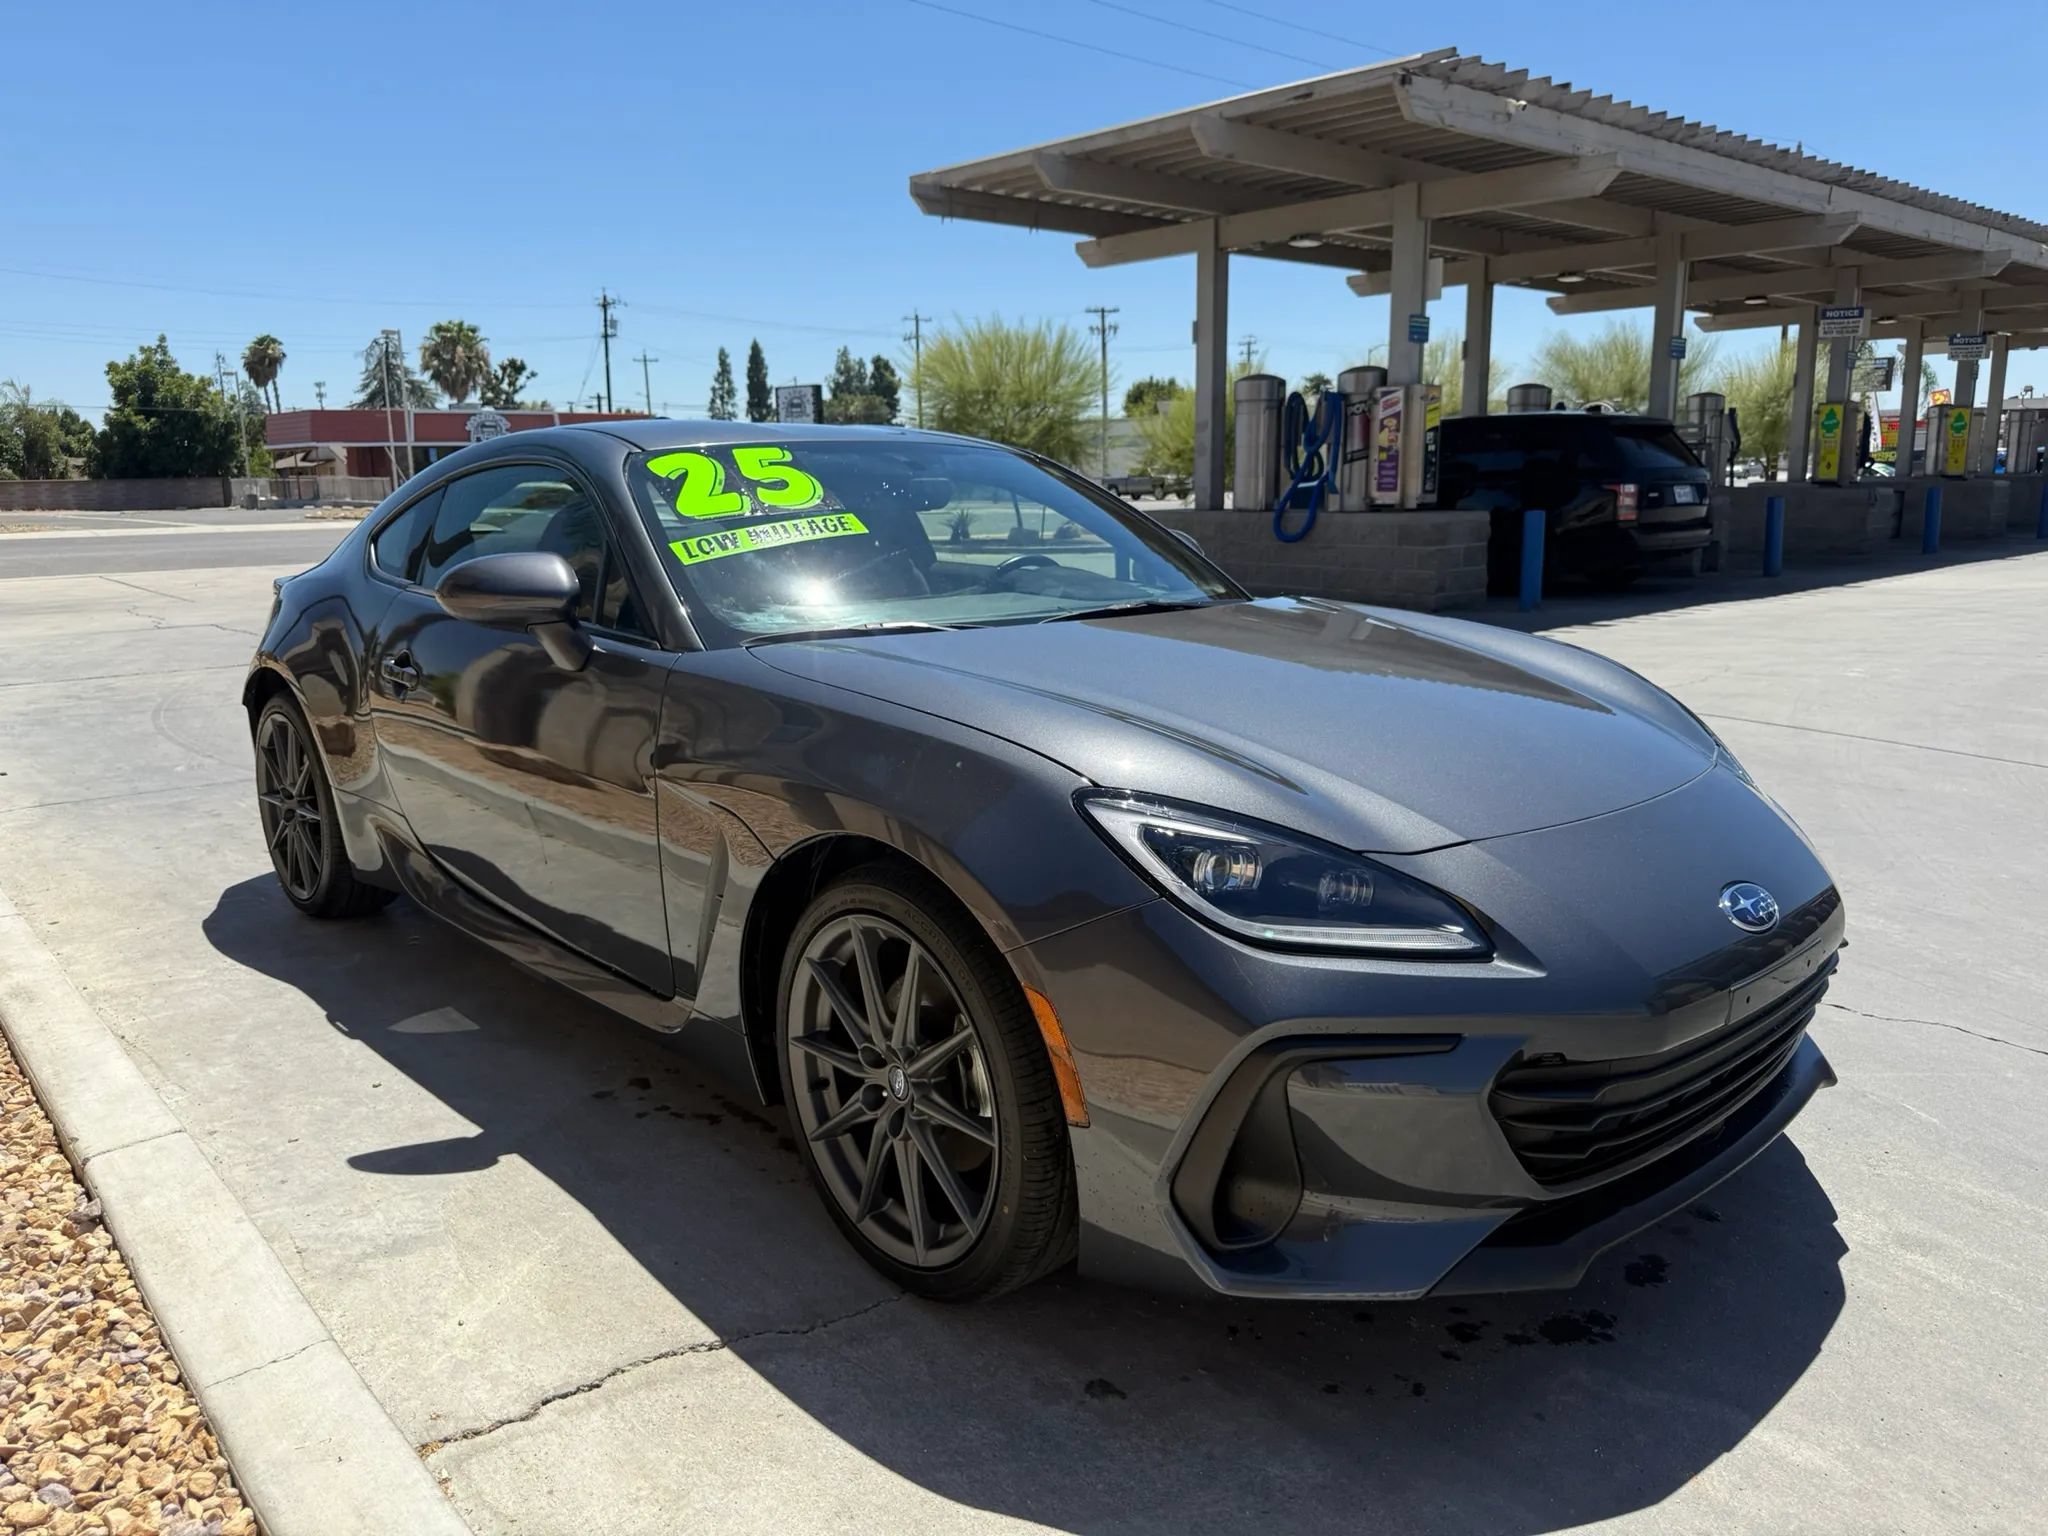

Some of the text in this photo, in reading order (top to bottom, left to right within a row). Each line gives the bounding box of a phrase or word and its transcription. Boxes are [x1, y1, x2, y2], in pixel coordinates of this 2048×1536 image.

[1826, 309, 1859, 318] NOTICE
[1953, 337, 1982, 345] NOTICE
[646, 447, 824, 519] 25
[681, 516, 853, 559] LOW MILEAGE
